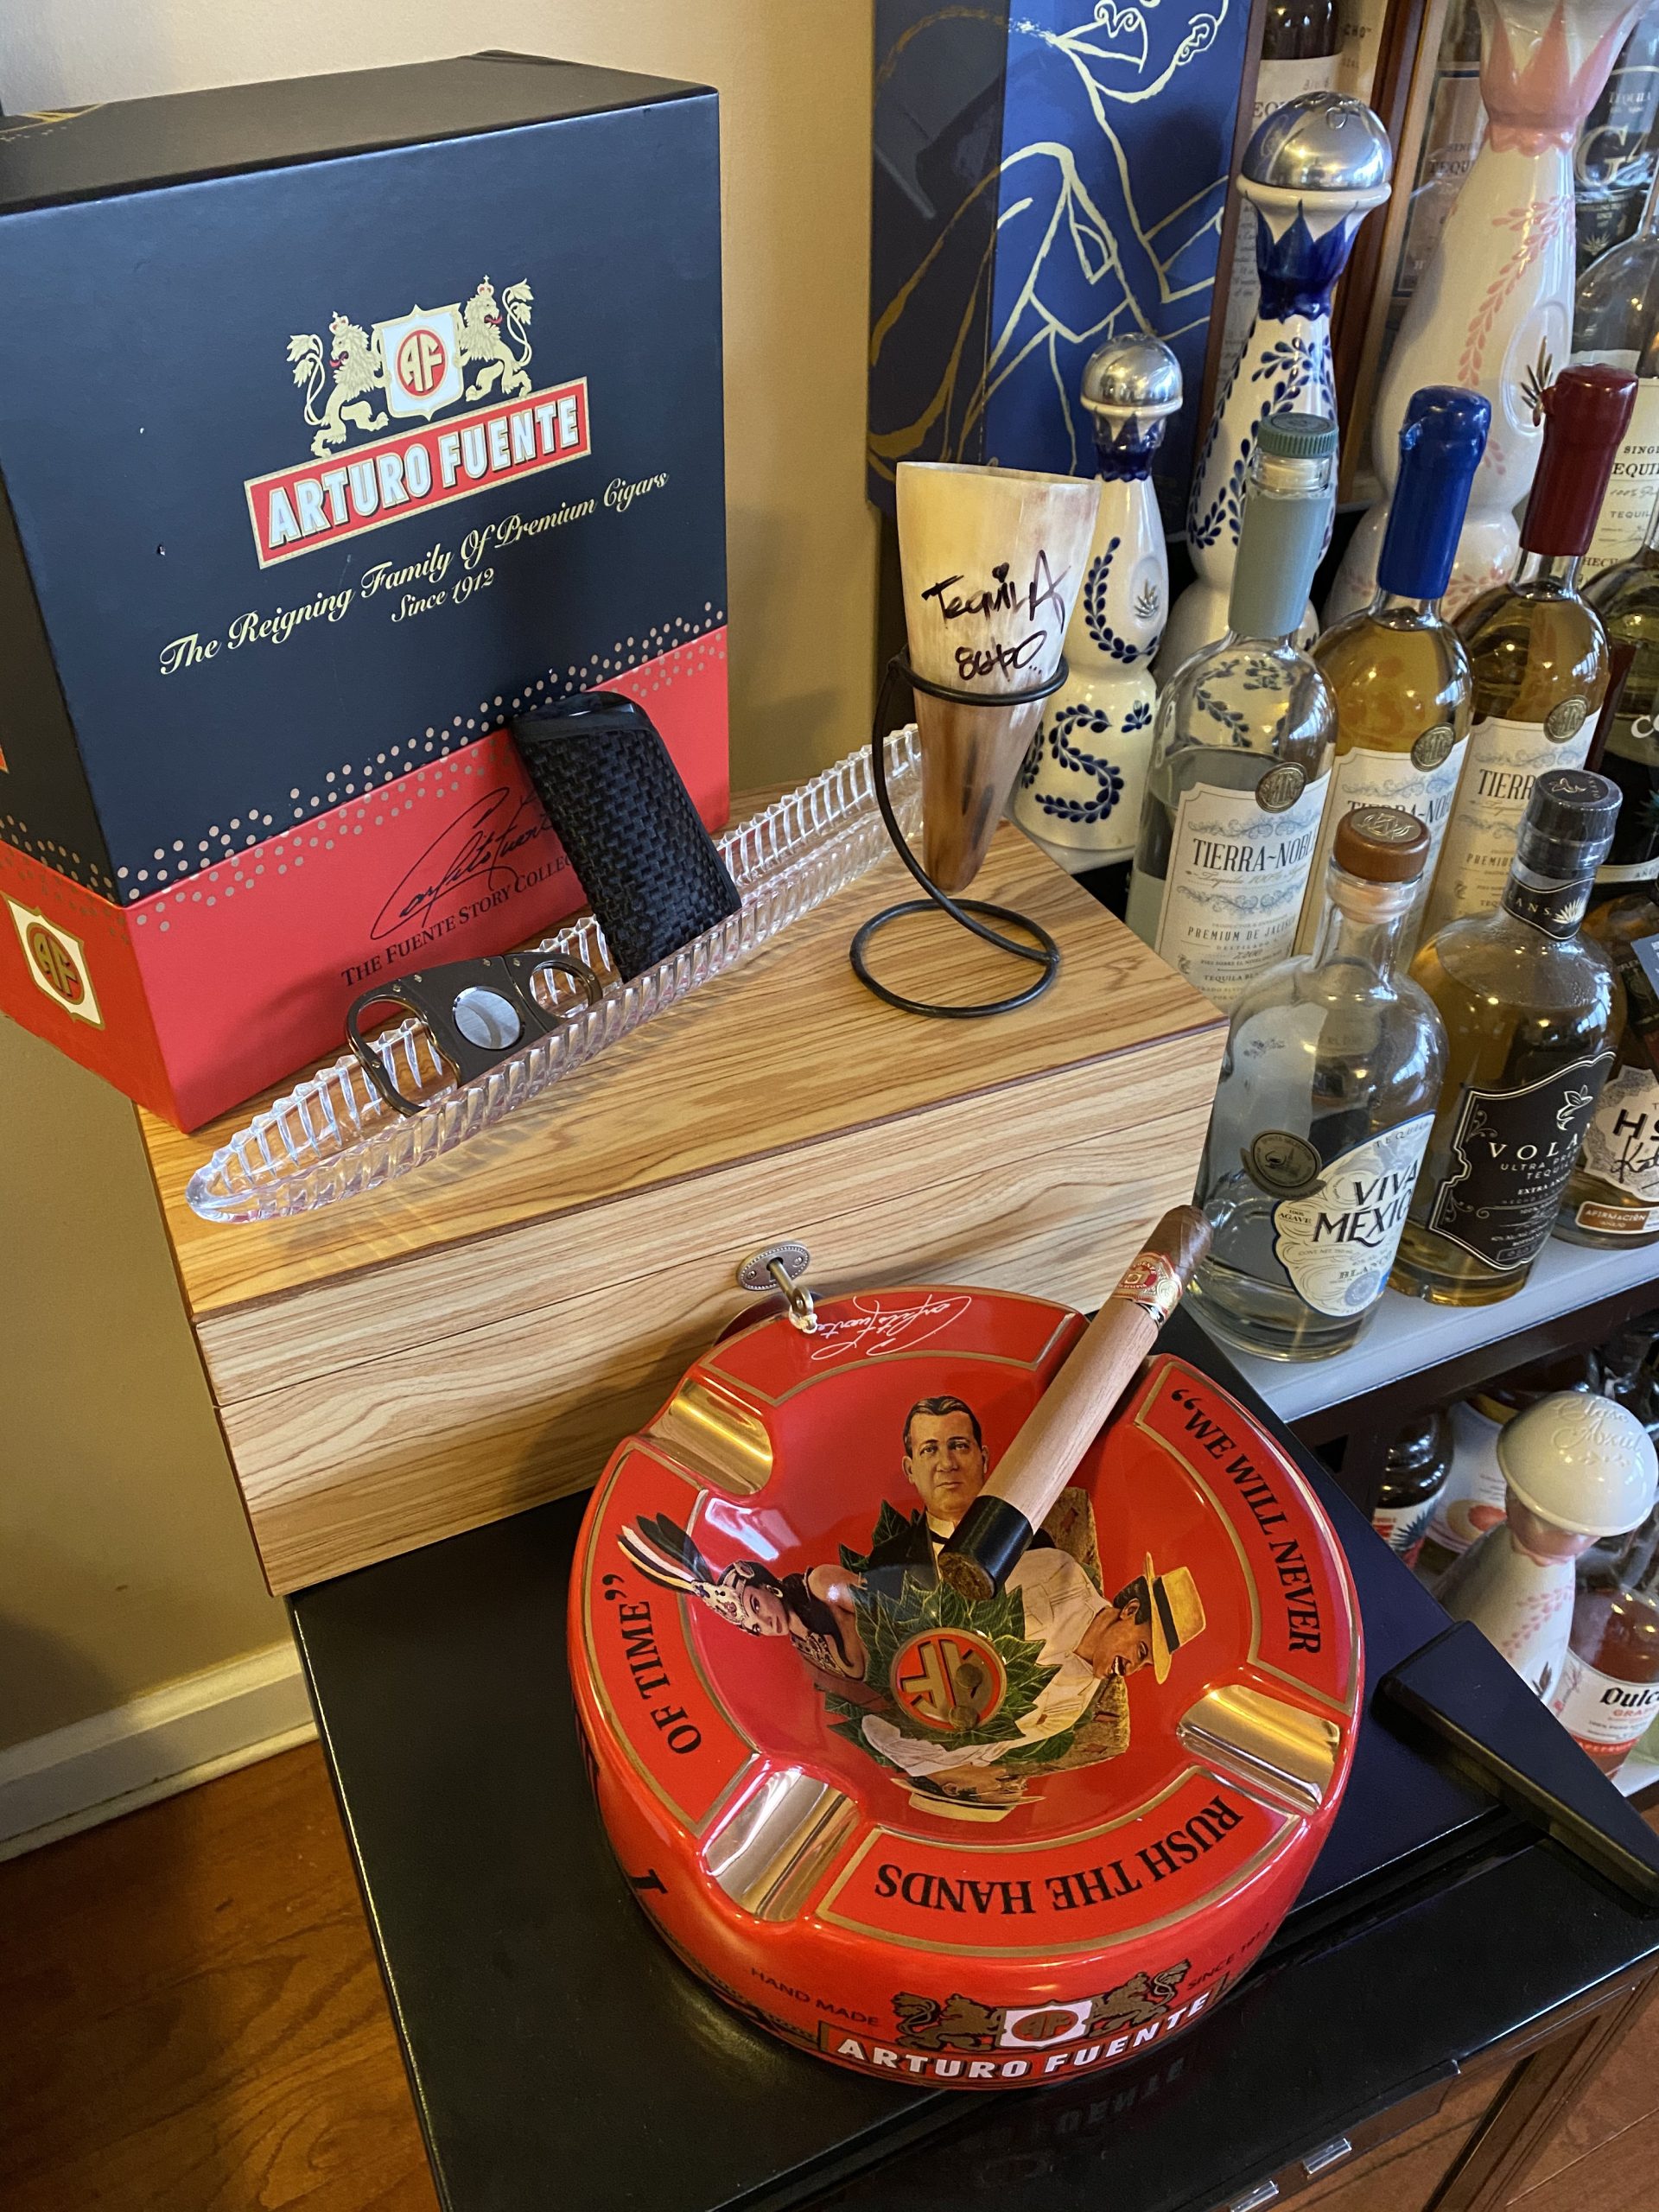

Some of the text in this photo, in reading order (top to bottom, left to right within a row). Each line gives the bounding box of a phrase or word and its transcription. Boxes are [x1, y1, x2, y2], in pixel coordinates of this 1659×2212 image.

[401, 333, 447, 394] AF
[267, 394, 581, 550] ARTURO FUENTE
[1623, 445, 1659, 454] SING
[1610, 510, 1651, 519] TEQUIL
[158, 472, 670, 676] The Reigning Family Of Premium Cigars
[391, 567, 495, 623] Since 1912
[340, 854, 575, 988] THE FUENTE STORY COLLEC
[1187, 925, 1241, 942] PREMIUM
[1246, 929, 1260, 941] DE
[1204, 975, 1243, 984] TEQUILA
[1352, 1159, 1420, 1207] VIVA
[1500, 1161, 1546, 1171] ULTRA
[1277, 1213, 1312, 1224] AGAVE
[1225, 1452, 1289, 1536] WILL
[1268, 1538, 1322, 1654] NEVER
[649, 1705, 702, 1755] OF
[874, 1795, 1245, 1916] RUSH THE HANDS
[751, 1966, 880, 2027] HAND MADE
[836, 1992, 1210, 2080] ARTURO FUENTE
